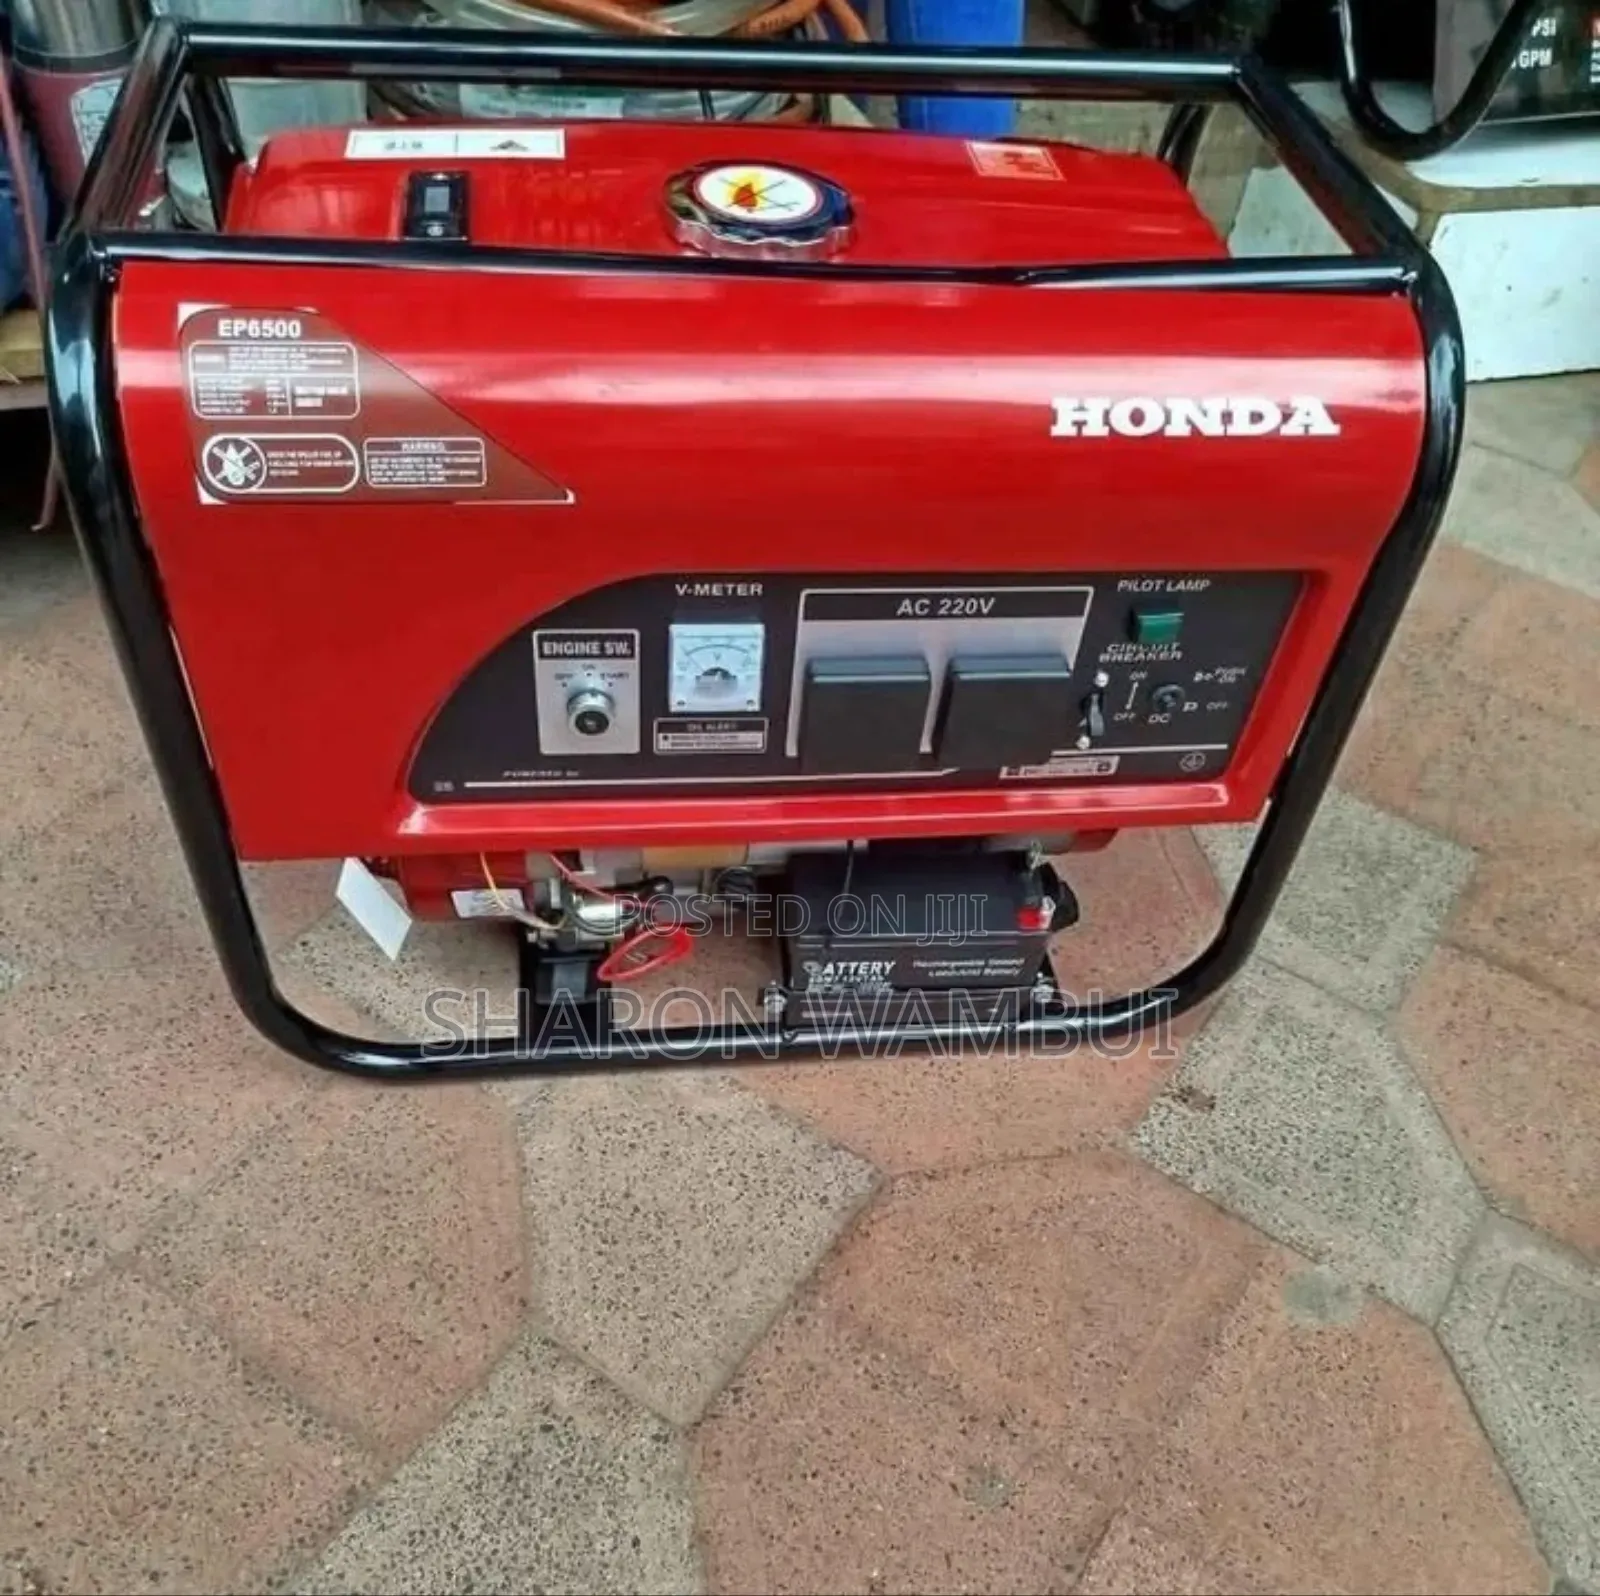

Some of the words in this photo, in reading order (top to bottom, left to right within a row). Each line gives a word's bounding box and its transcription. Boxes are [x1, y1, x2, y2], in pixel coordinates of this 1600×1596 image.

[1519, 48, 1552, 69] GPM
[218, 319, 302, 338] EP6500
[1050, 396, 1341, 437] HONDA
[674, 583, 764, 597] V-METER
[1117, 579, 1164, 592] PILOT
[1166, 578, 1211, 592] LAMP
[896, 597, 931, 616] AC
[936, 596, 996, 616] 220V
[542, 641, 601, 656] ENGINE
[1130, 671, 1148, 681] ON
[1148, 712, 1171, 724] DC
